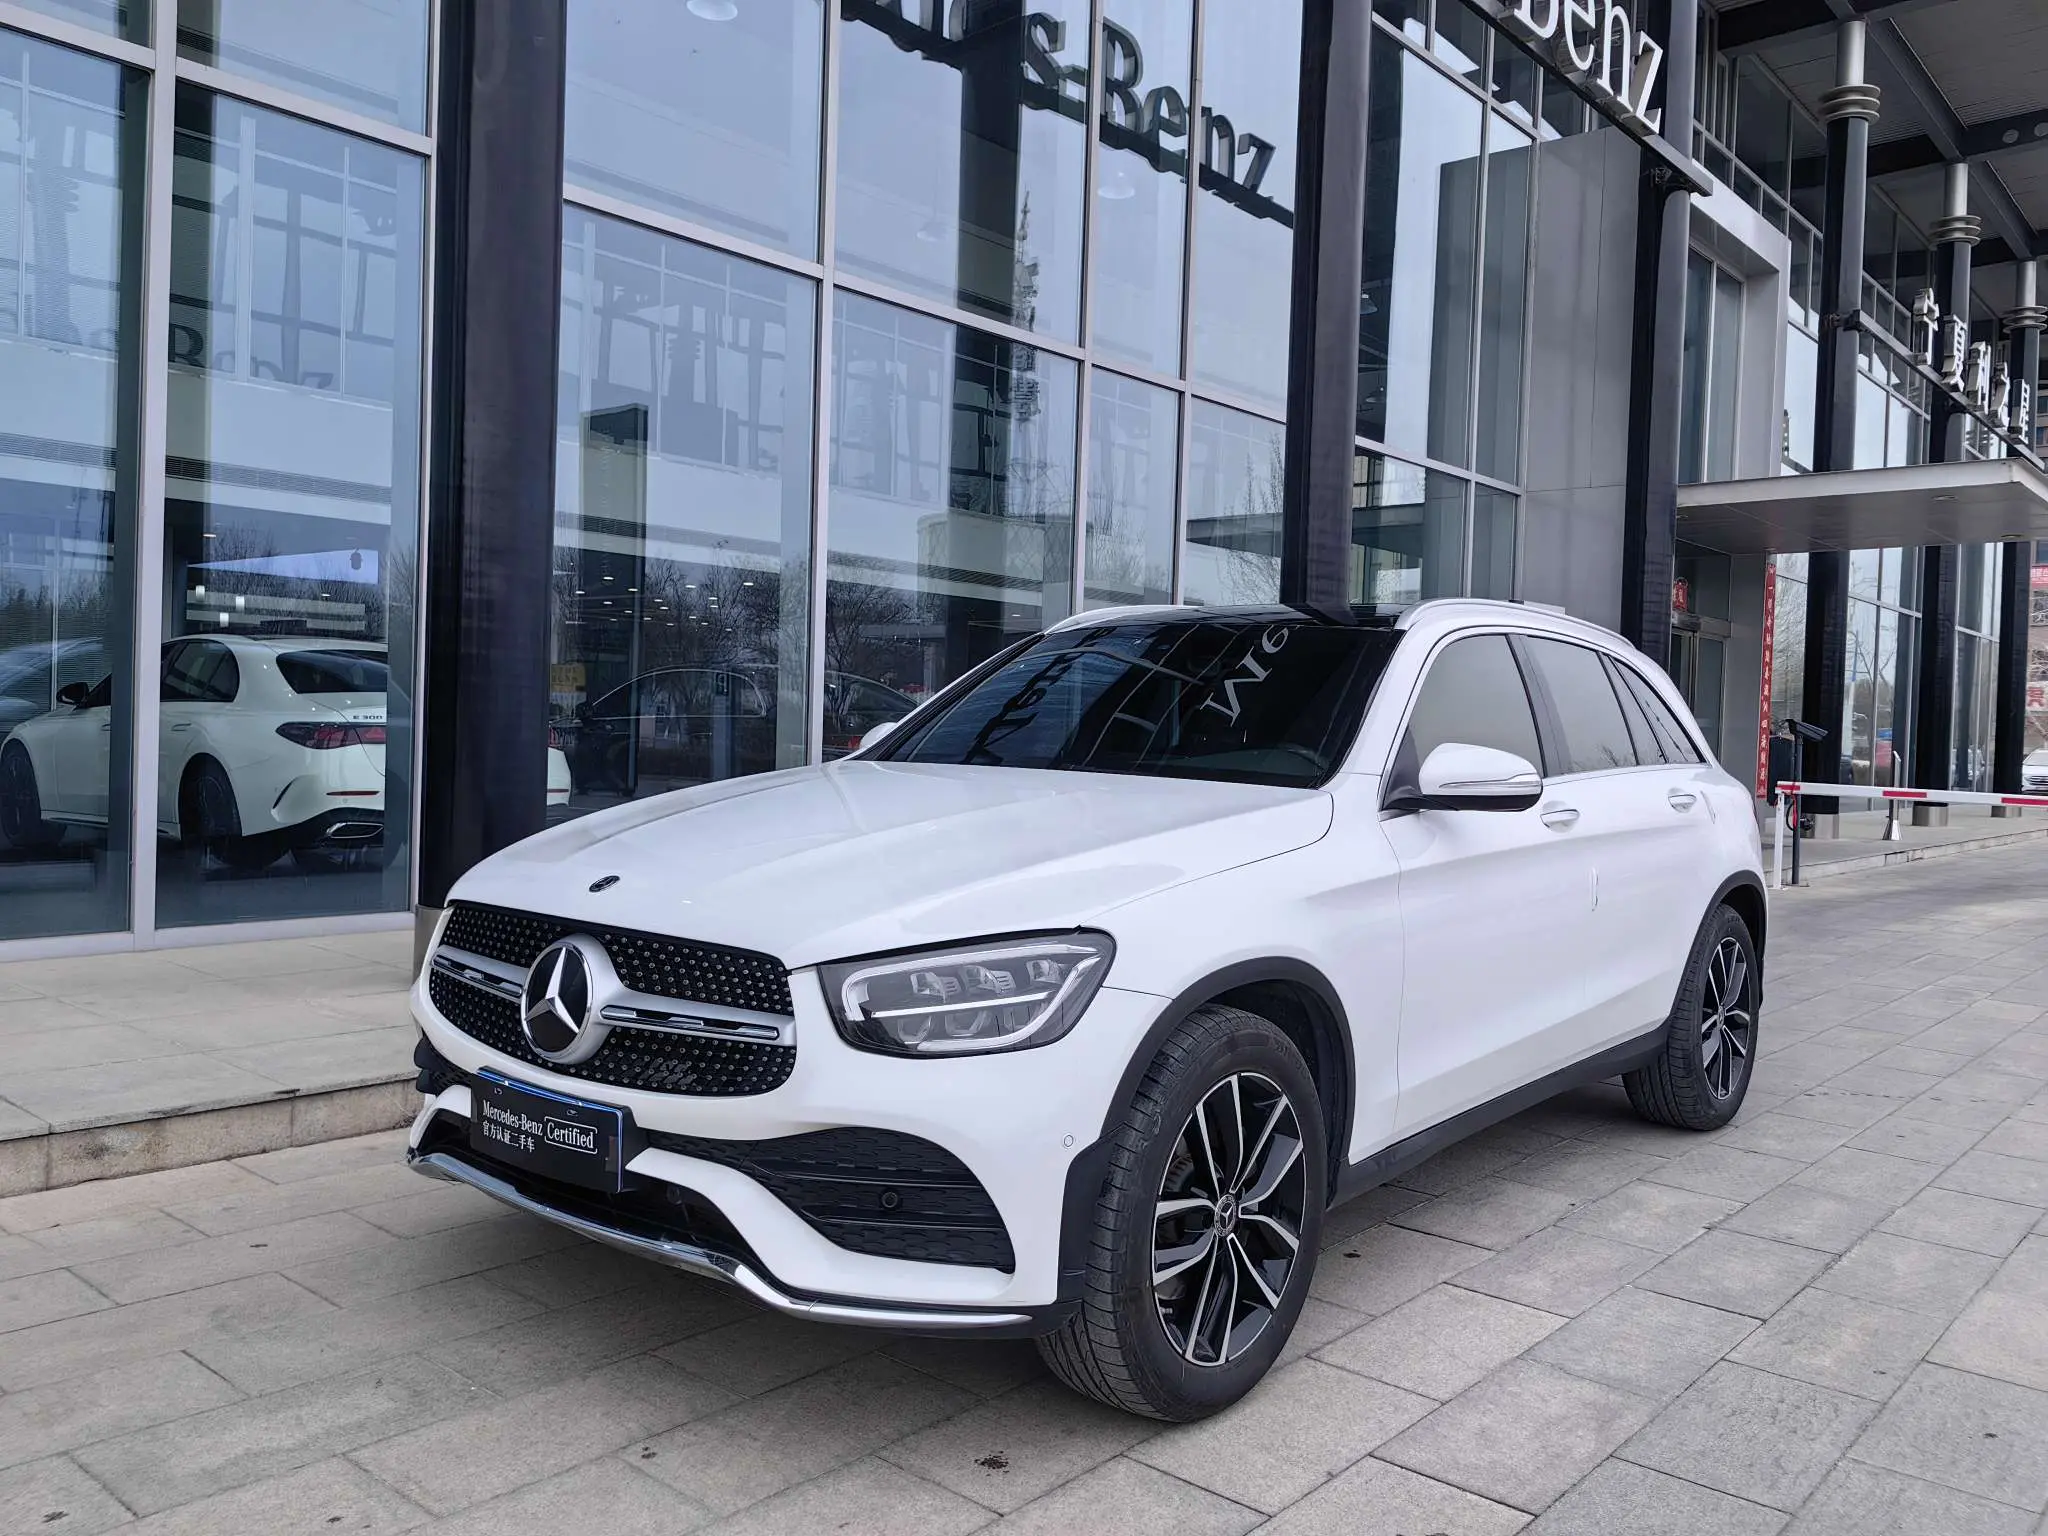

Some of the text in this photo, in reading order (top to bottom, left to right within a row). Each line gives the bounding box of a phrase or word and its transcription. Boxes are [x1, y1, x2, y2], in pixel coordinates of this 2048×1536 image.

[483, 1100, 594, 1149] Mercedes-Benz Certified
[483, 1120, 535, 1153] 官方认证二手车
